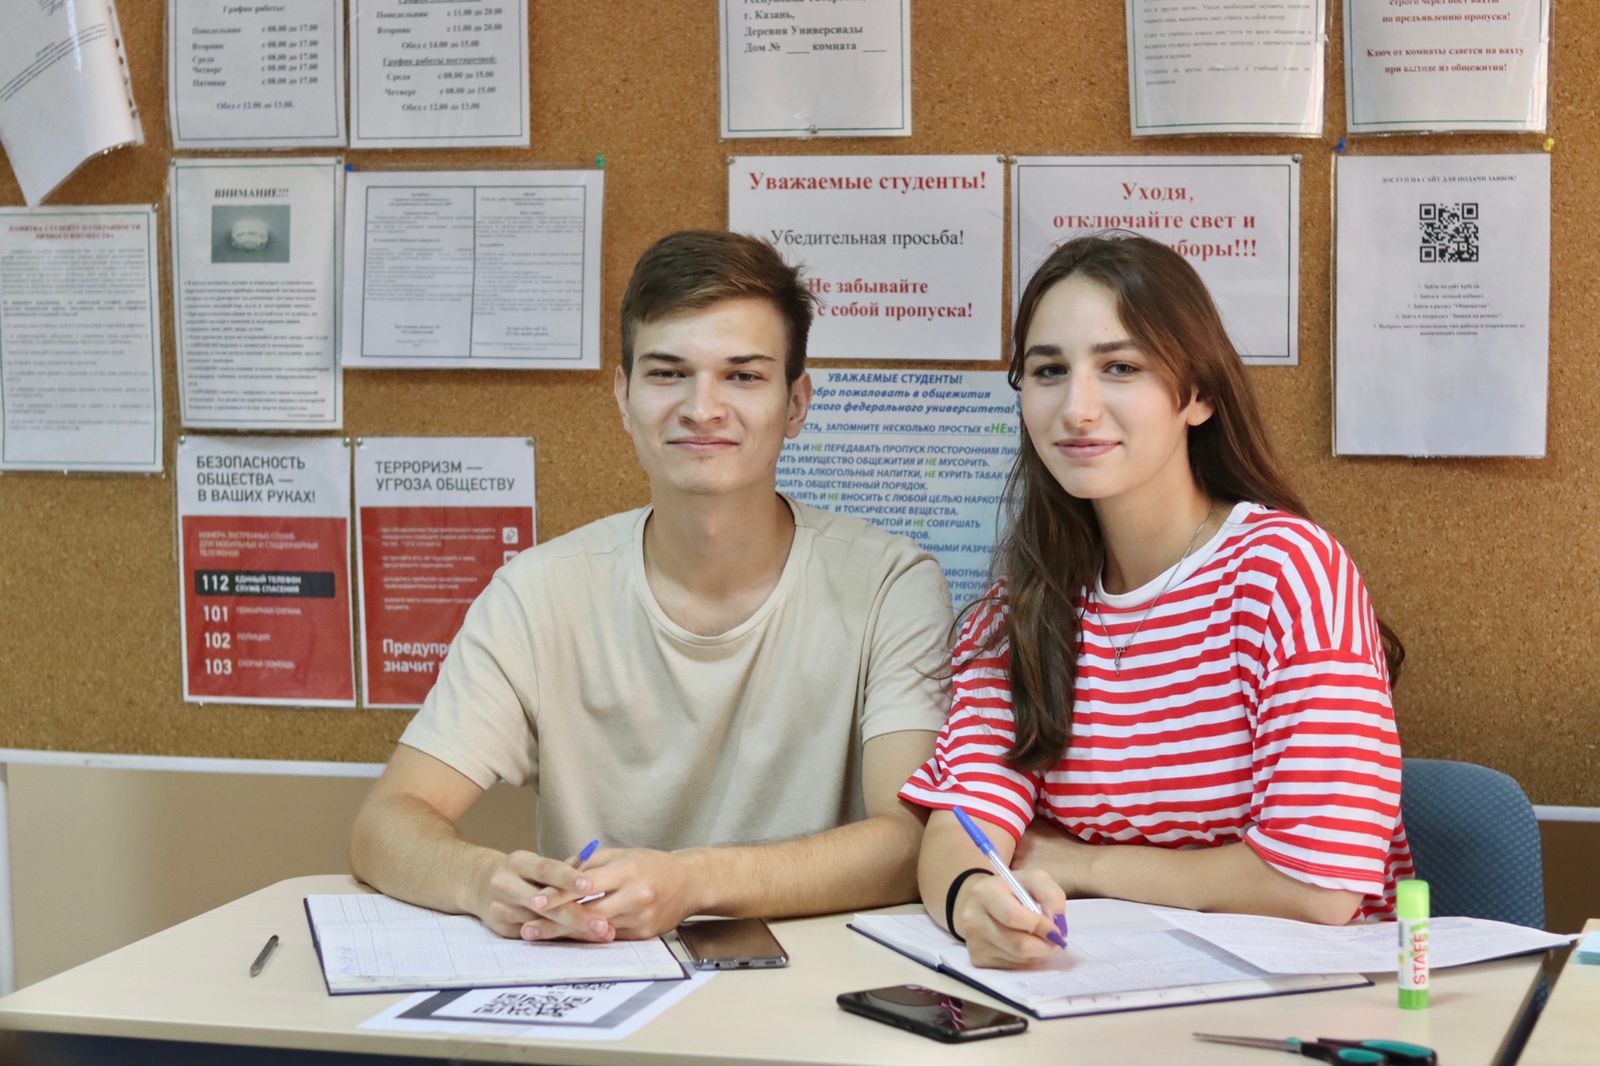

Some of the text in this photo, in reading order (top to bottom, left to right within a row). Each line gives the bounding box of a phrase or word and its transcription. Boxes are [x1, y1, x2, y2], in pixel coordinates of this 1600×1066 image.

[755, 10, 796, 20] Казань,
[1464, 12, 1511, 23] пропуска!
[744, 25, 863, 38] Деревня Универсиады
[744, 42, 766, 54] Дом
[812, 42, 857, 52] комната
[1367, 48, 1390, 58] Ключ
[1405, 48, 1446, 56] комнаты
[1500, 48, 1524, 57] вахту
[1385, 66, 1402, 74] при
[1404, 65, 1437, 73] выходе
[1451, 63, 1508, 72] общежития!
[749, 172, 987, 194] Уважаемые студенты!
[1121, 182, 1195, 203] Уходя,
[1053, 212, 1256, 229] отключайте свет и
[771, 229, 964, 249] Убедительная просьба!
[1171, 239, 1257, 262] боры!!!
[807, 278, 928, 294] Не забывайте
[818, 302, 973, 321] с собой пропуска!
[828, 372, 963, 385] УВАЖАЕМЫЕ СТУДЕНТЫ!
[838, 389, 910, 398] пожаловать
[922, 390, 990, 400] общежития
[808, 400, 1016, 414] ского федерального университета!
[826, 423, 880, 432] ЗАПОМНИТЕ
[882, 424, 936, 433] НЕСКОЛЬКО
[938, 425, 982, 434] ПРОСТЫХ
[811, 444, 822, 452] НЕ
[824, 444, 881, 454] ПЕРЕДАВАТЬ
[883, 444, 925, 454] ПРОПУСК
[927, 446, 999, 454] ПОСТОРОННИМ
[196, 455, 306, 470] БЕЗОПАСНОСТЬ
[375, 460, 462, 474] ТЕРРОРИЗМ
[798, 456, 854, 465] ИМУЩЕСТВО
[856, 456, 915, 466] ОБЩЕЖИТИЯ
[926, 458, 936, 466] НЕ
[938, 458, 990, 468] МУСОРИТЬ.
[196, 472, 274, 487] ОБЩЕСТВА
[808, 468, 1002, 480] АЛКОГОЛЬНЫЕ НАПИТКИ, НЕ КУРИТЬ ТАБАК
[375, 477, 516, 493] УГРОЗА ОБЩЕСТВУ
[805, 479, 880, 490] ОБЩЕСТВЕННЫЙ
[882, 482, 928, 491] ПОРЯДОК.
[198, 489, 316, 503] В ВАШИХ РУКАХ!
[820, 492, 826, 500] И
[828, 492, 840, 500] НЕ
[841, 493, 883, 502] ВНОСИТЬ
[892, 494, 927, 502] ЛЮБОЙ
[928, 495, 962, 504] ЦЕЛЬЮ
[964, 496, 1000, 504] НАРКОТ
[834, 505, 842, 514] И
[844, 504, 906, 515] ТОКСИЧЕСКИЕ
[908, 506, 958, 516] ВЕЩЕСТВА.
[905, 518, 982, 528] И НЕ СОВЕРШАТЬ
[202, 574, 230, 592] 112
[204, 605, 228, 622] 101
[204, 632, 231, 649] 102
[382, 638, 449, 658] Предупр
[206, 658, 232, 675] 103
[383, 660, 434, 673] значит
[1413, 932, 1426, 985] STAFF
